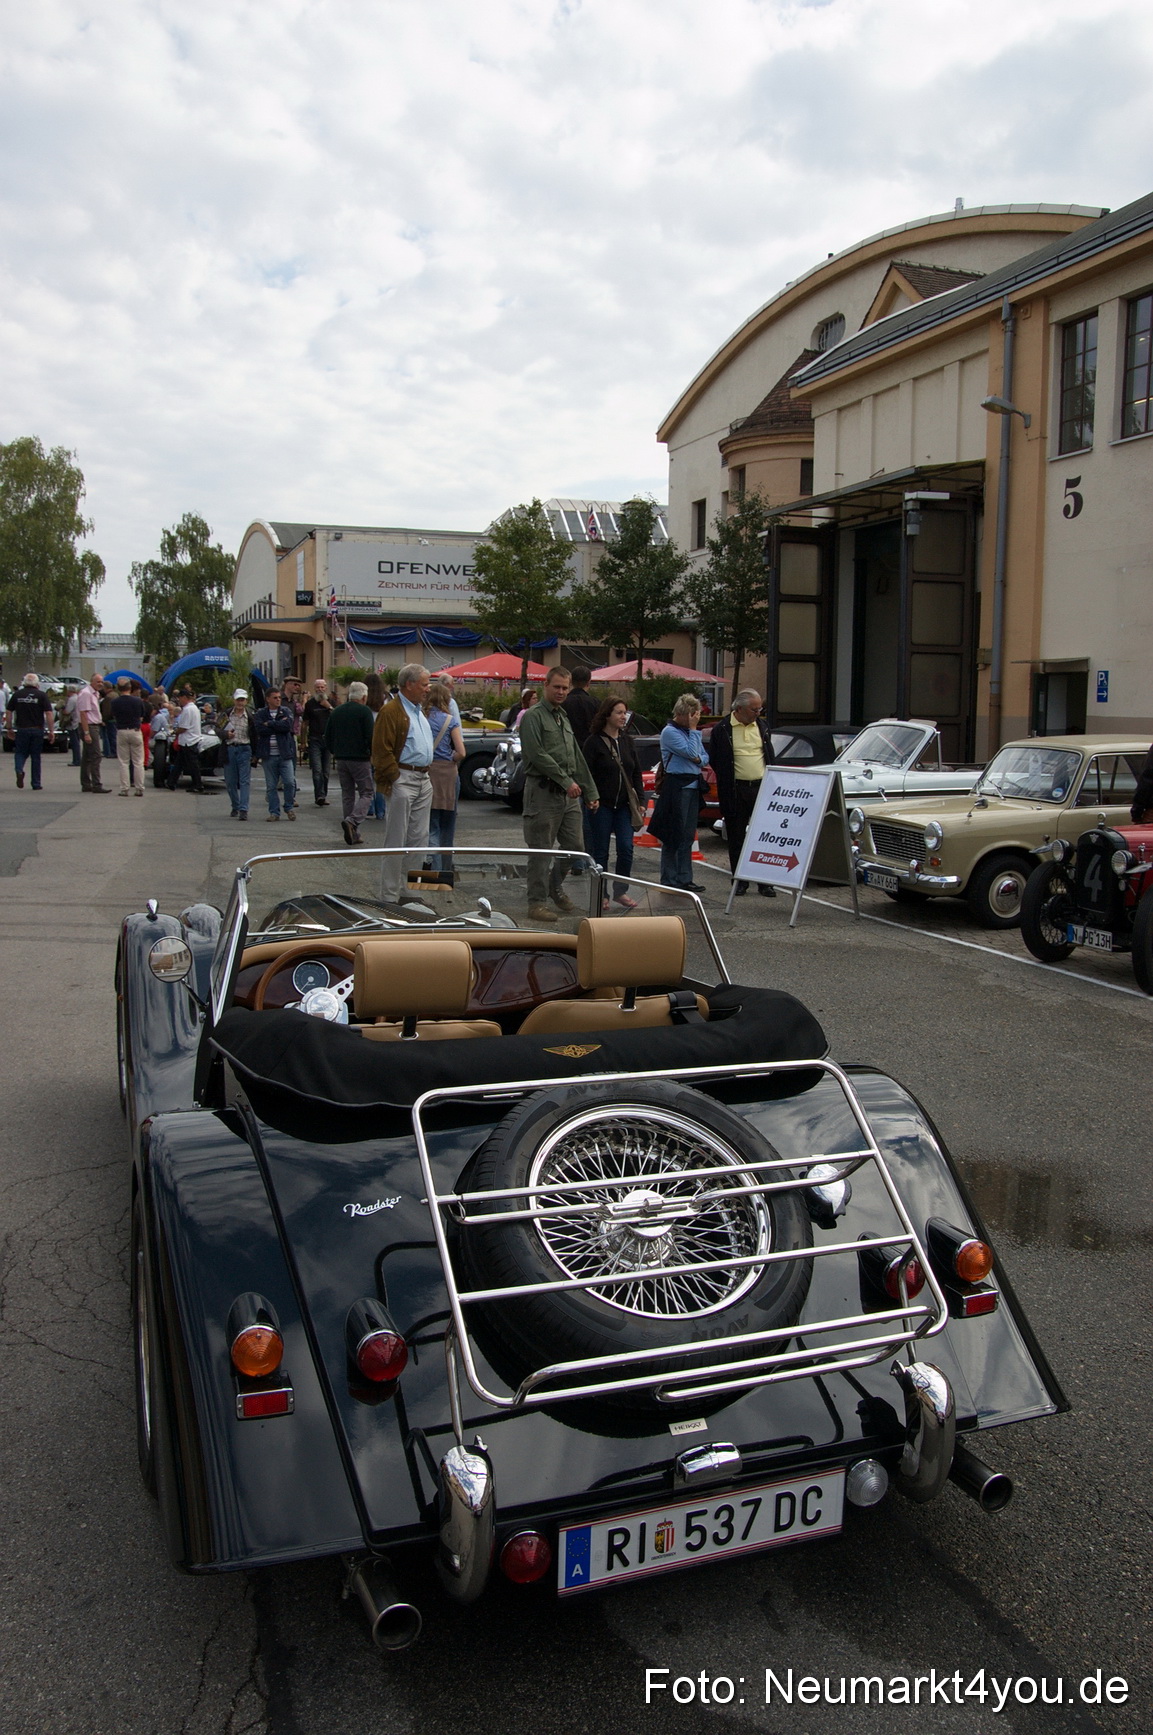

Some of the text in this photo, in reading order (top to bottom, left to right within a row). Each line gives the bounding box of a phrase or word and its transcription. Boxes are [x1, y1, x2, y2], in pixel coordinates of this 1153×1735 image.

[1063, 475, 1084, 520] 5
[377, 560, 482, 577] OFENWE
[377, 580, 477, 592] ZENTRUM FÜR MOB
[297, 593, 312, 603] sky
[772, 786, 814, 800] Austin-
[767, 801, 808, 817] Healey
[780, 818, 789, 829] &
[758, 831, 802, 848] Morgan
[756, 853, 789, 867] Parking
[1083, 854, 1103, 903] 4
[1085, 929, 1094, 945] PG
[1095, 932, 1112, 950] 13H
[342, 1195, 402, 1218] Roadster
[571, 1485, 823, 1578] A RI 537 DC
